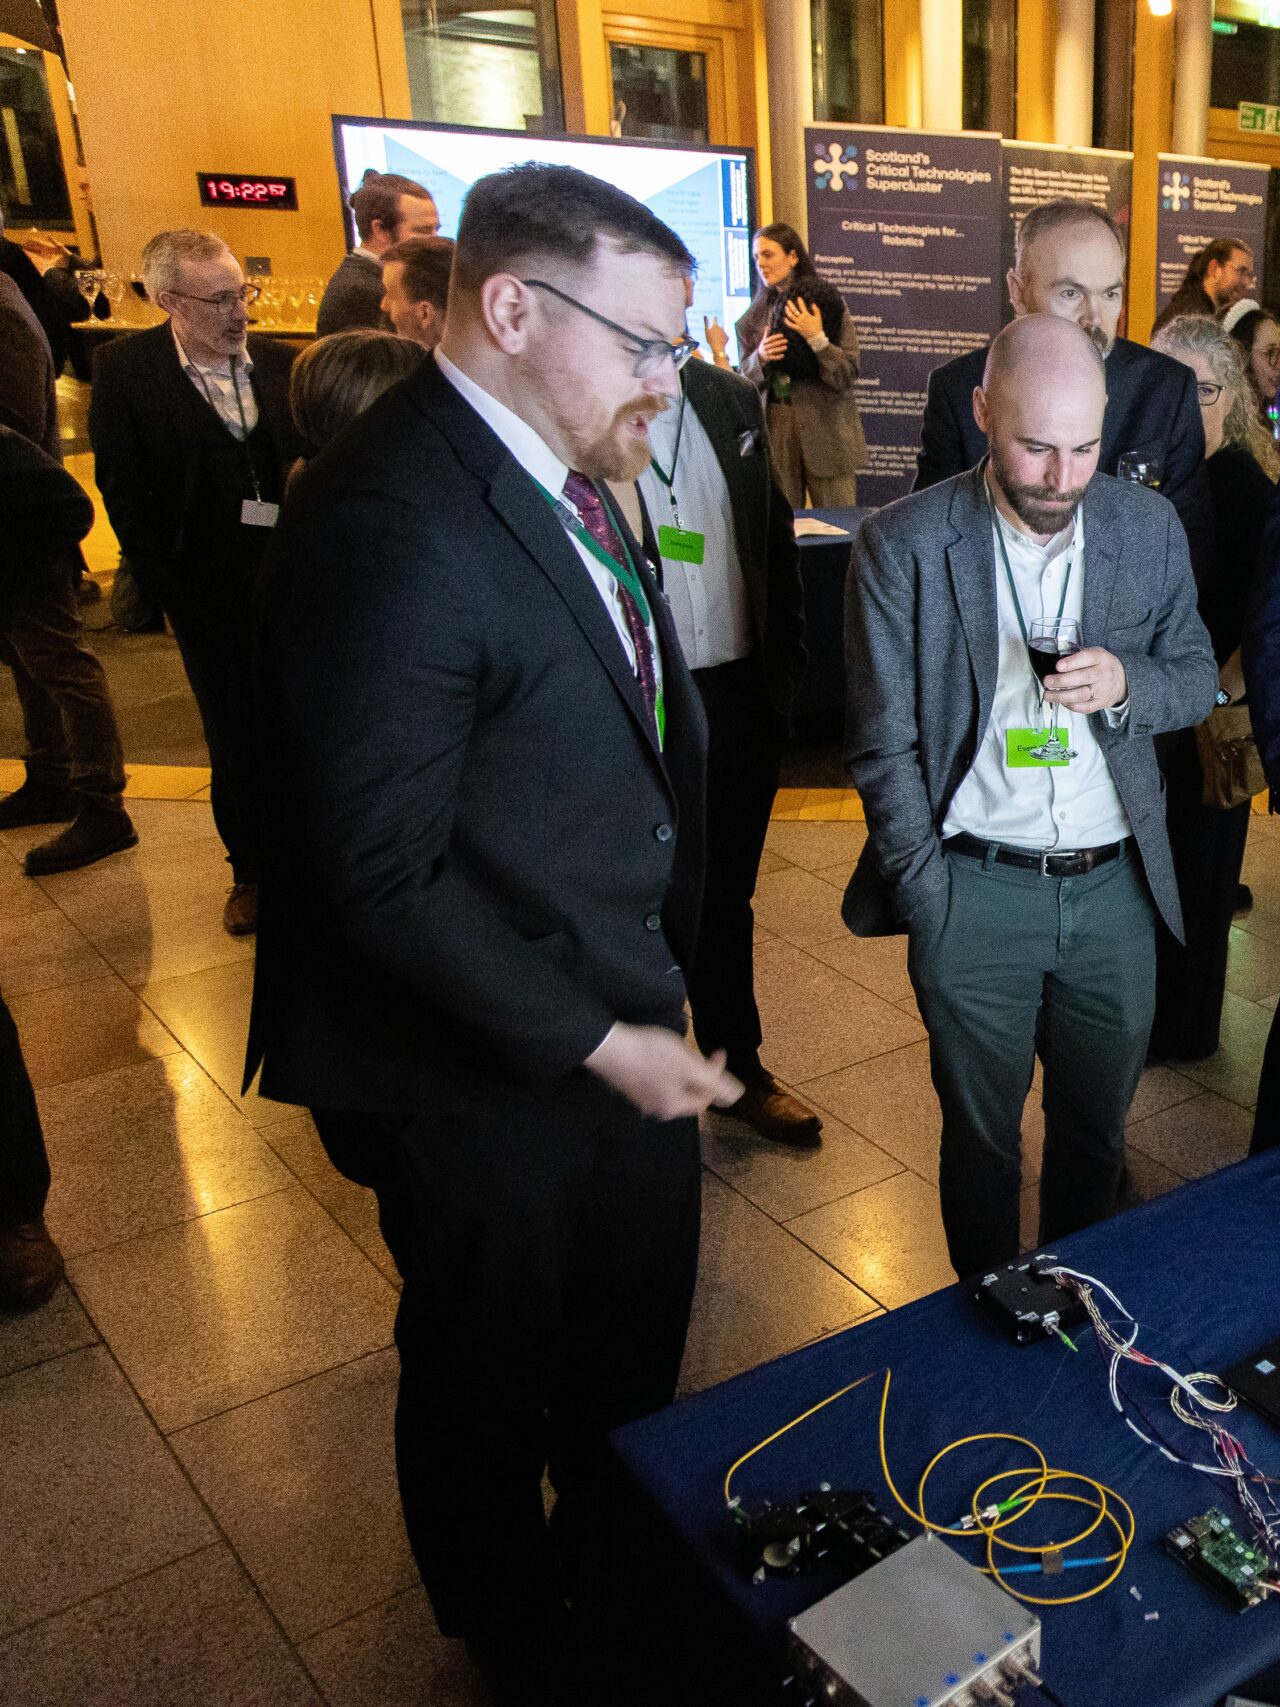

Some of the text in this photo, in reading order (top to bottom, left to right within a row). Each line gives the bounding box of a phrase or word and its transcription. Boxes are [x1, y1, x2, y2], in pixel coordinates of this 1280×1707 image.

[866, 149, 930, 165] Scotland's
[866, 163, 992, 184] Critical Technologies
[866, 177, 943, 193] Supercluster
[1193, 177, 1231, 191] Scotland's
[1219, 190, 1264, 206] Technologies
[841, 220, 876, 232] Critical
[878, 222, 941, 237] Technologies
[882, 234, 925, 248] Robotics
